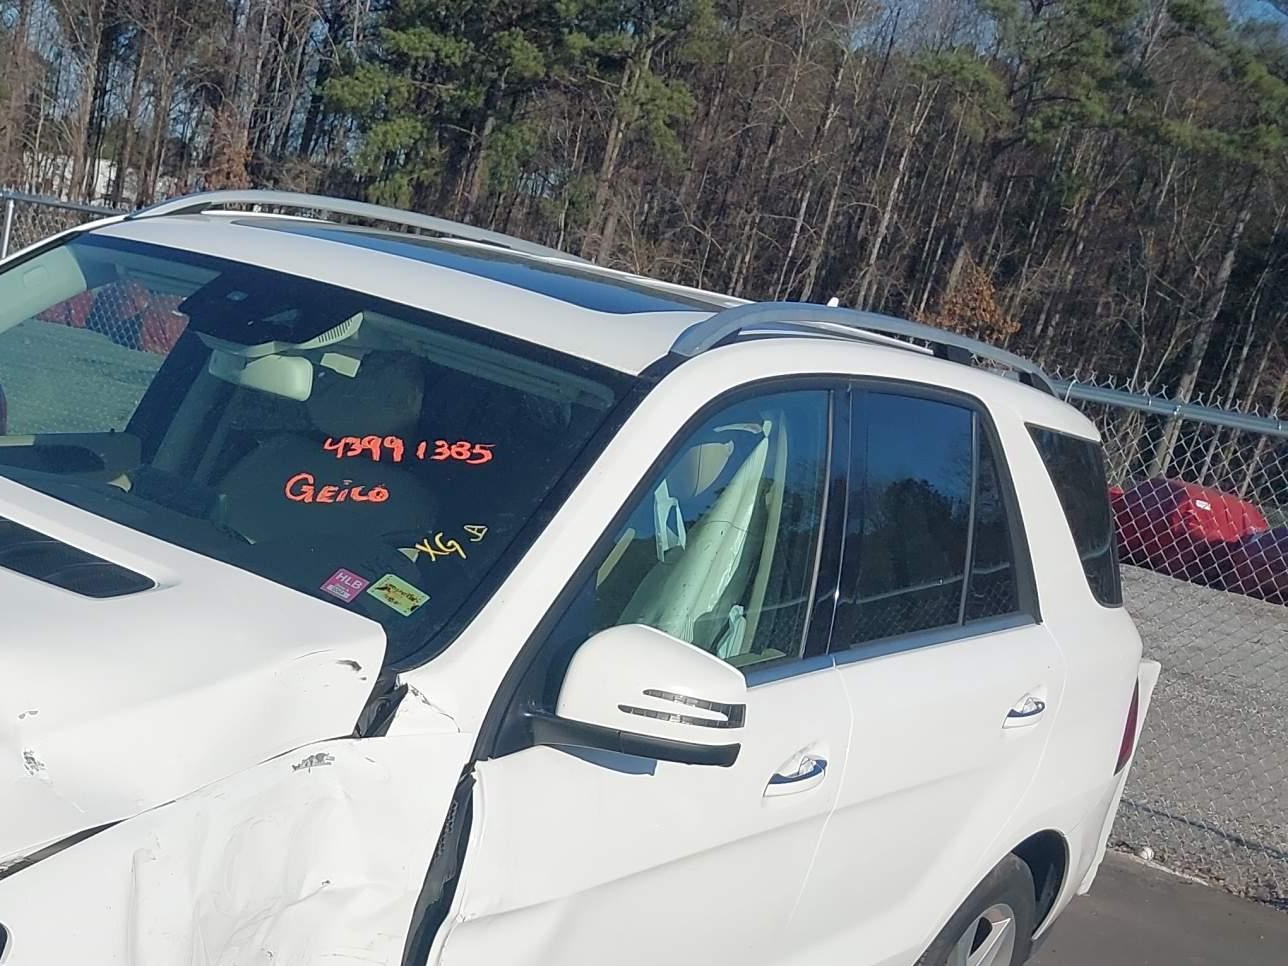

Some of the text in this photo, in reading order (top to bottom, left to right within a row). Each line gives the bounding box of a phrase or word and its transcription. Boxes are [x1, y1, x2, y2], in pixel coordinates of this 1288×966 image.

[323, 435, 496, 465] 4399 1385
[335, 572, 363, 589] HLB
